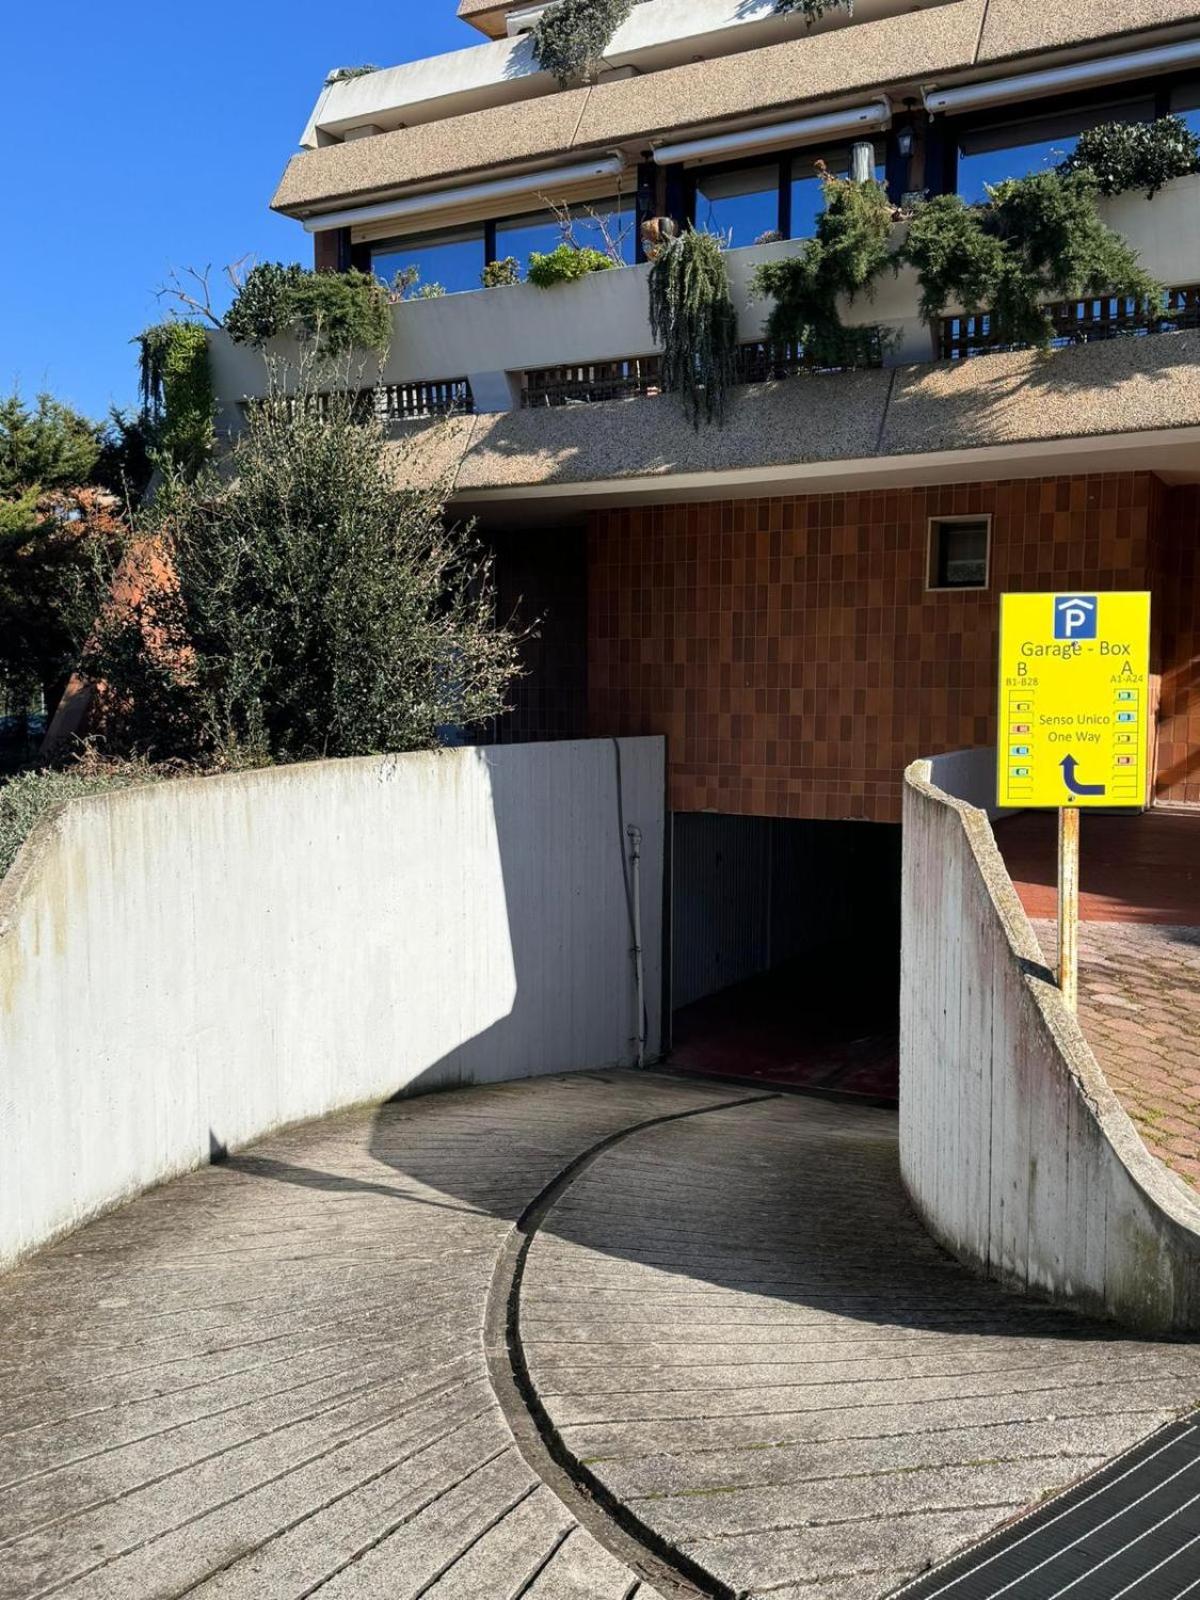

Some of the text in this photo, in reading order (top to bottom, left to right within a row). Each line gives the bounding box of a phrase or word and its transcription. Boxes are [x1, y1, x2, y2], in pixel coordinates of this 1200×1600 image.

[1065, 608, 1086, 637] P
[1021, 641, 1082, 660] Garage
[1100, 641, 1130, 655] Box
[1017, 662, 1028, 677] B
[1121, 661, 1133, 675] A
[1006, 678, 1039, 687] B1-B28
[1110, 675, 1143, 683] A1-A24
[1039, 714, 1110, 725] Senso Unico
[1048, 732, 1101, 743] One Way
